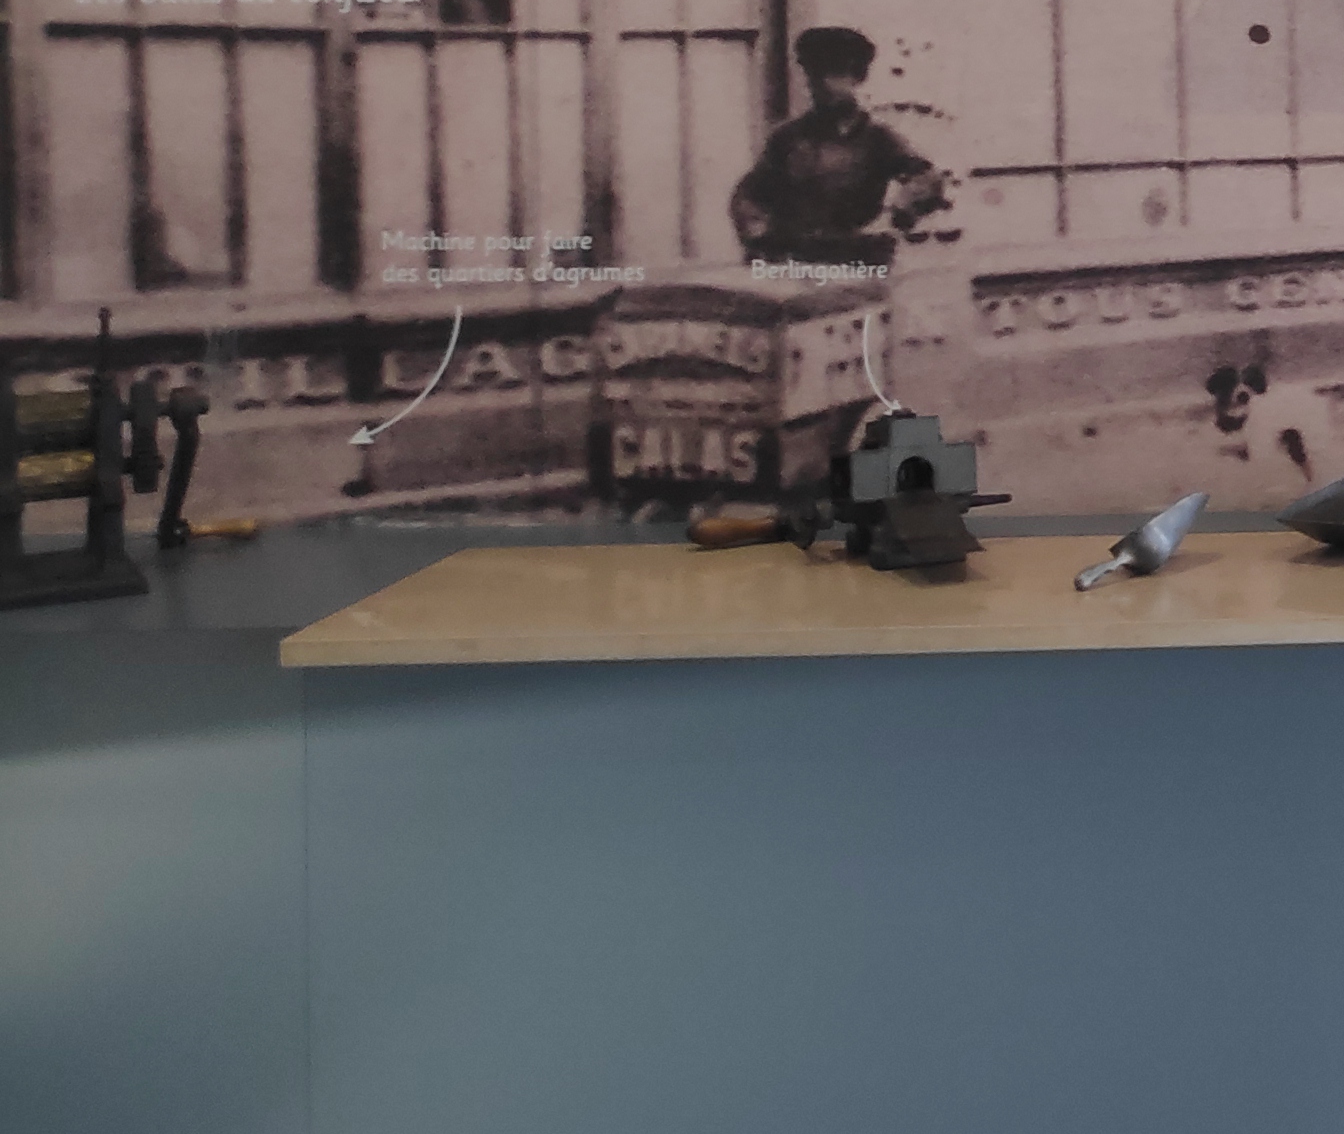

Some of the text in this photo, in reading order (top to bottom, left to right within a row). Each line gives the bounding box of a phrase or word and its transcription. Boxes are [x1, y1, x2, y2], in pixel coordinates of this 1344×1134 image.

[381, 229, 593, 257] Machine pour faire
[382, 264, 645, 289] des quartiers d'agrumes
[751, 257, 888, 287] Berlingotière
